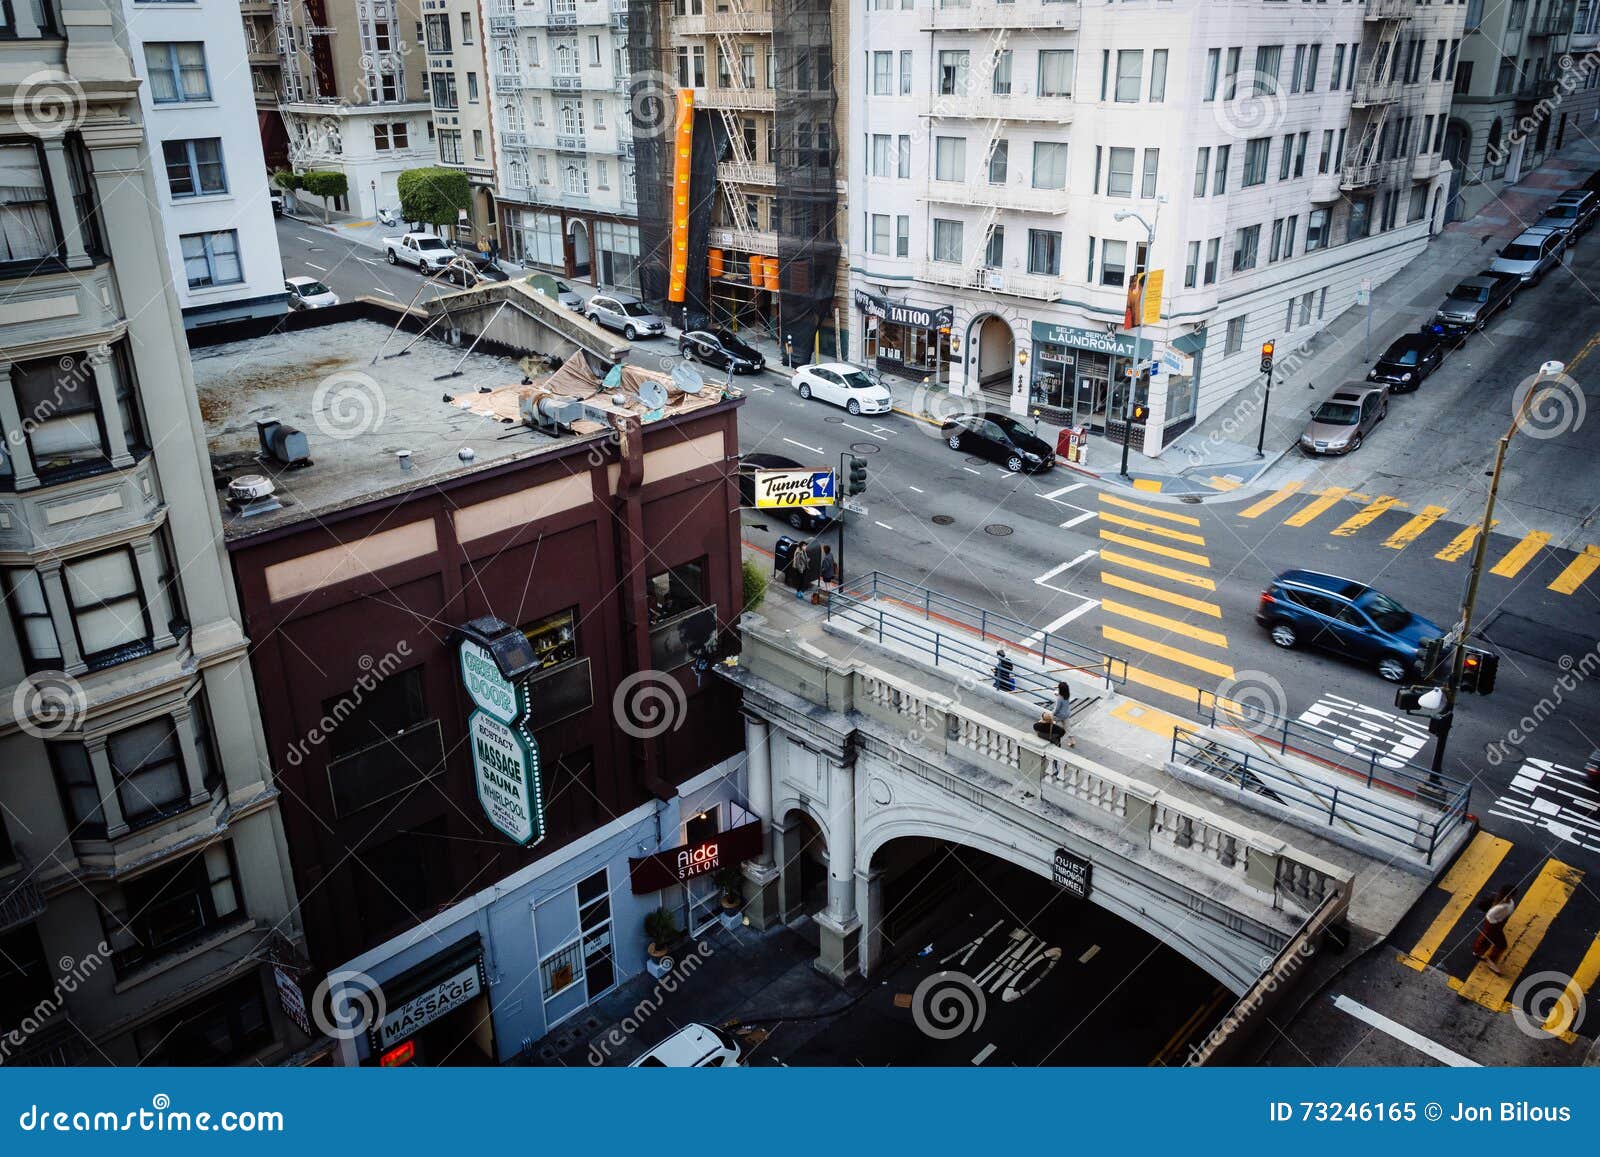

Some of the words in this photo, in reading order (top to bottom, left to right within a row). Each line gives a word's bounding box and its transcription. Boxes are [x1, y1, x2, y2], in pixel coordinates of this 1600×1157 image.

[891, 307, 930, 326] TATTOO
[1049, 331, 1135, 355] LAUNDROMAT
[1056, 326, 1075, 334] SELF
[1085, 331, 1116, 342] SERVICE
[762, 473, 815, 496] Tunnel
[775, 491, 810, 505] TOP
[469, 672, 512, 712] DOOR
[479, 723, 514, 751] ECSTACY
[477, 737, 522, 782] MASSAGE
[482, 766, 520, 799] SAUNA
[483, 782, 527, 820] WHIRLPOOL
[678, 843, 718, 867] Aida
[1055, 855, 1085, 876] QUIET
[679, 858, 719, 878] SALON
[1055, 873, 1084, 894] TUNNEL
[385, 978, 474, 1038] MASSAGE
